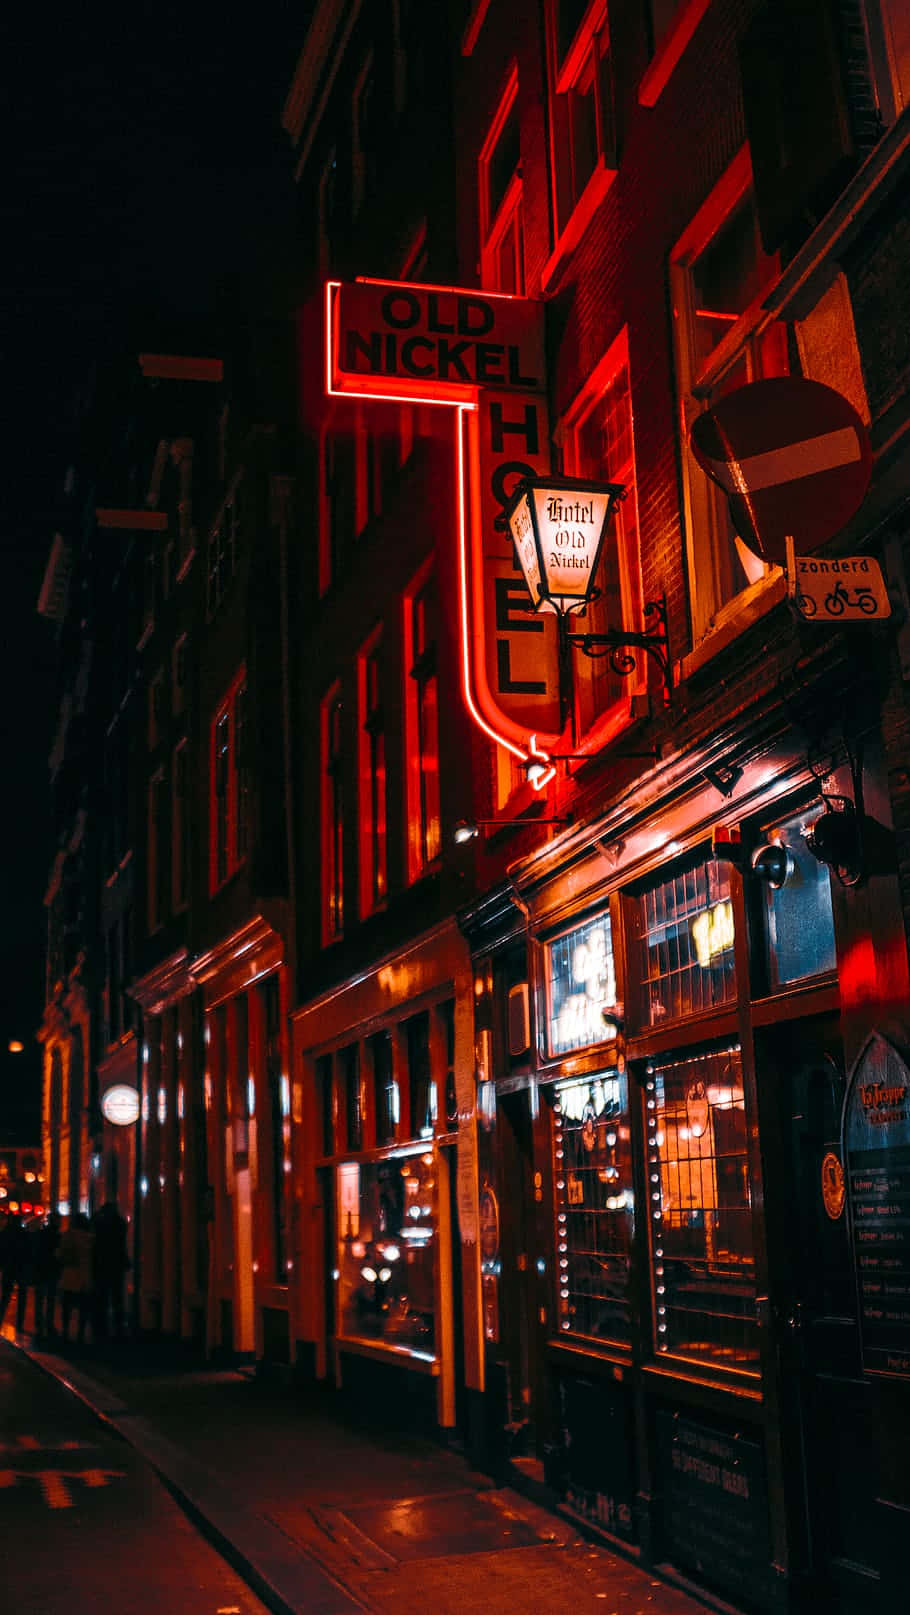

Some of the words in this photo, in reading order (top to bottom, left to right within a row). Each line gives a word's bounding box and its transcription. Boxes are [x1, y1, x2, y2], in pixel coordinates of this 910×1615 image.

[381, 292, 495, 336] OLD
[345, 330, 538, 386] NICKEL
[546, 496, 595, 524] Hotel
[490, 402, 547, 695] HOEL
[554, 529, 586, 549] Old
[549, 551, 592, 569] Nickel
[799, 559, 870, 574] zonderd
